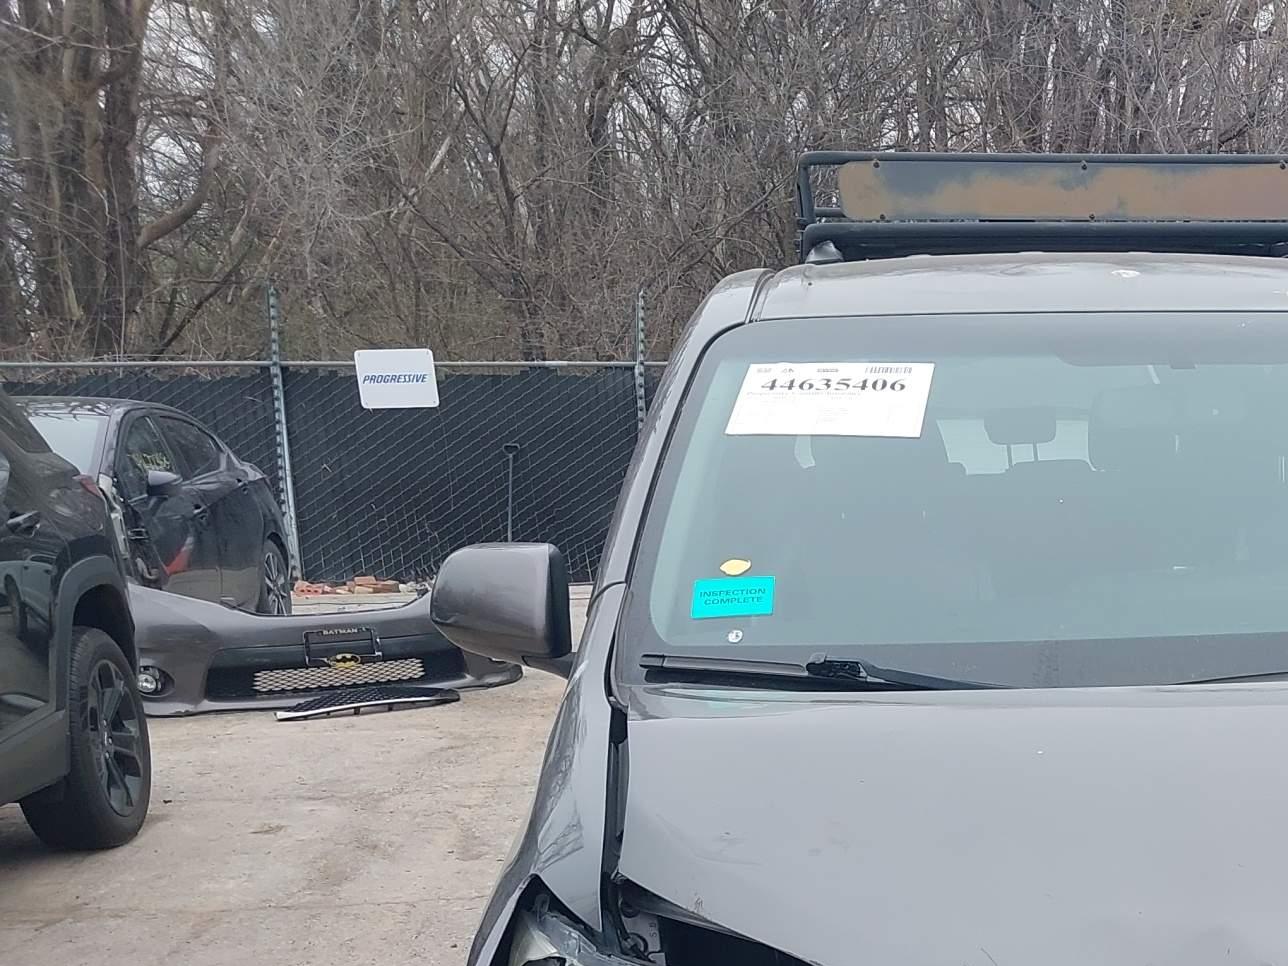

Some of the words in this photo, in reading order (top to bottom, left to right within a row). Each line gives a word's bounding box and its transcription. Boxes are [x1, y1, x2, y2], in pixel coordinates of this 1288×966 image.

[362, 374, 429, 385] PROGRESSIVE
[760, 378, 907, 392] 44635406
[700, 588, 766, 598] INSPECTION
[704, 596, 763, 606] COMPLETE
